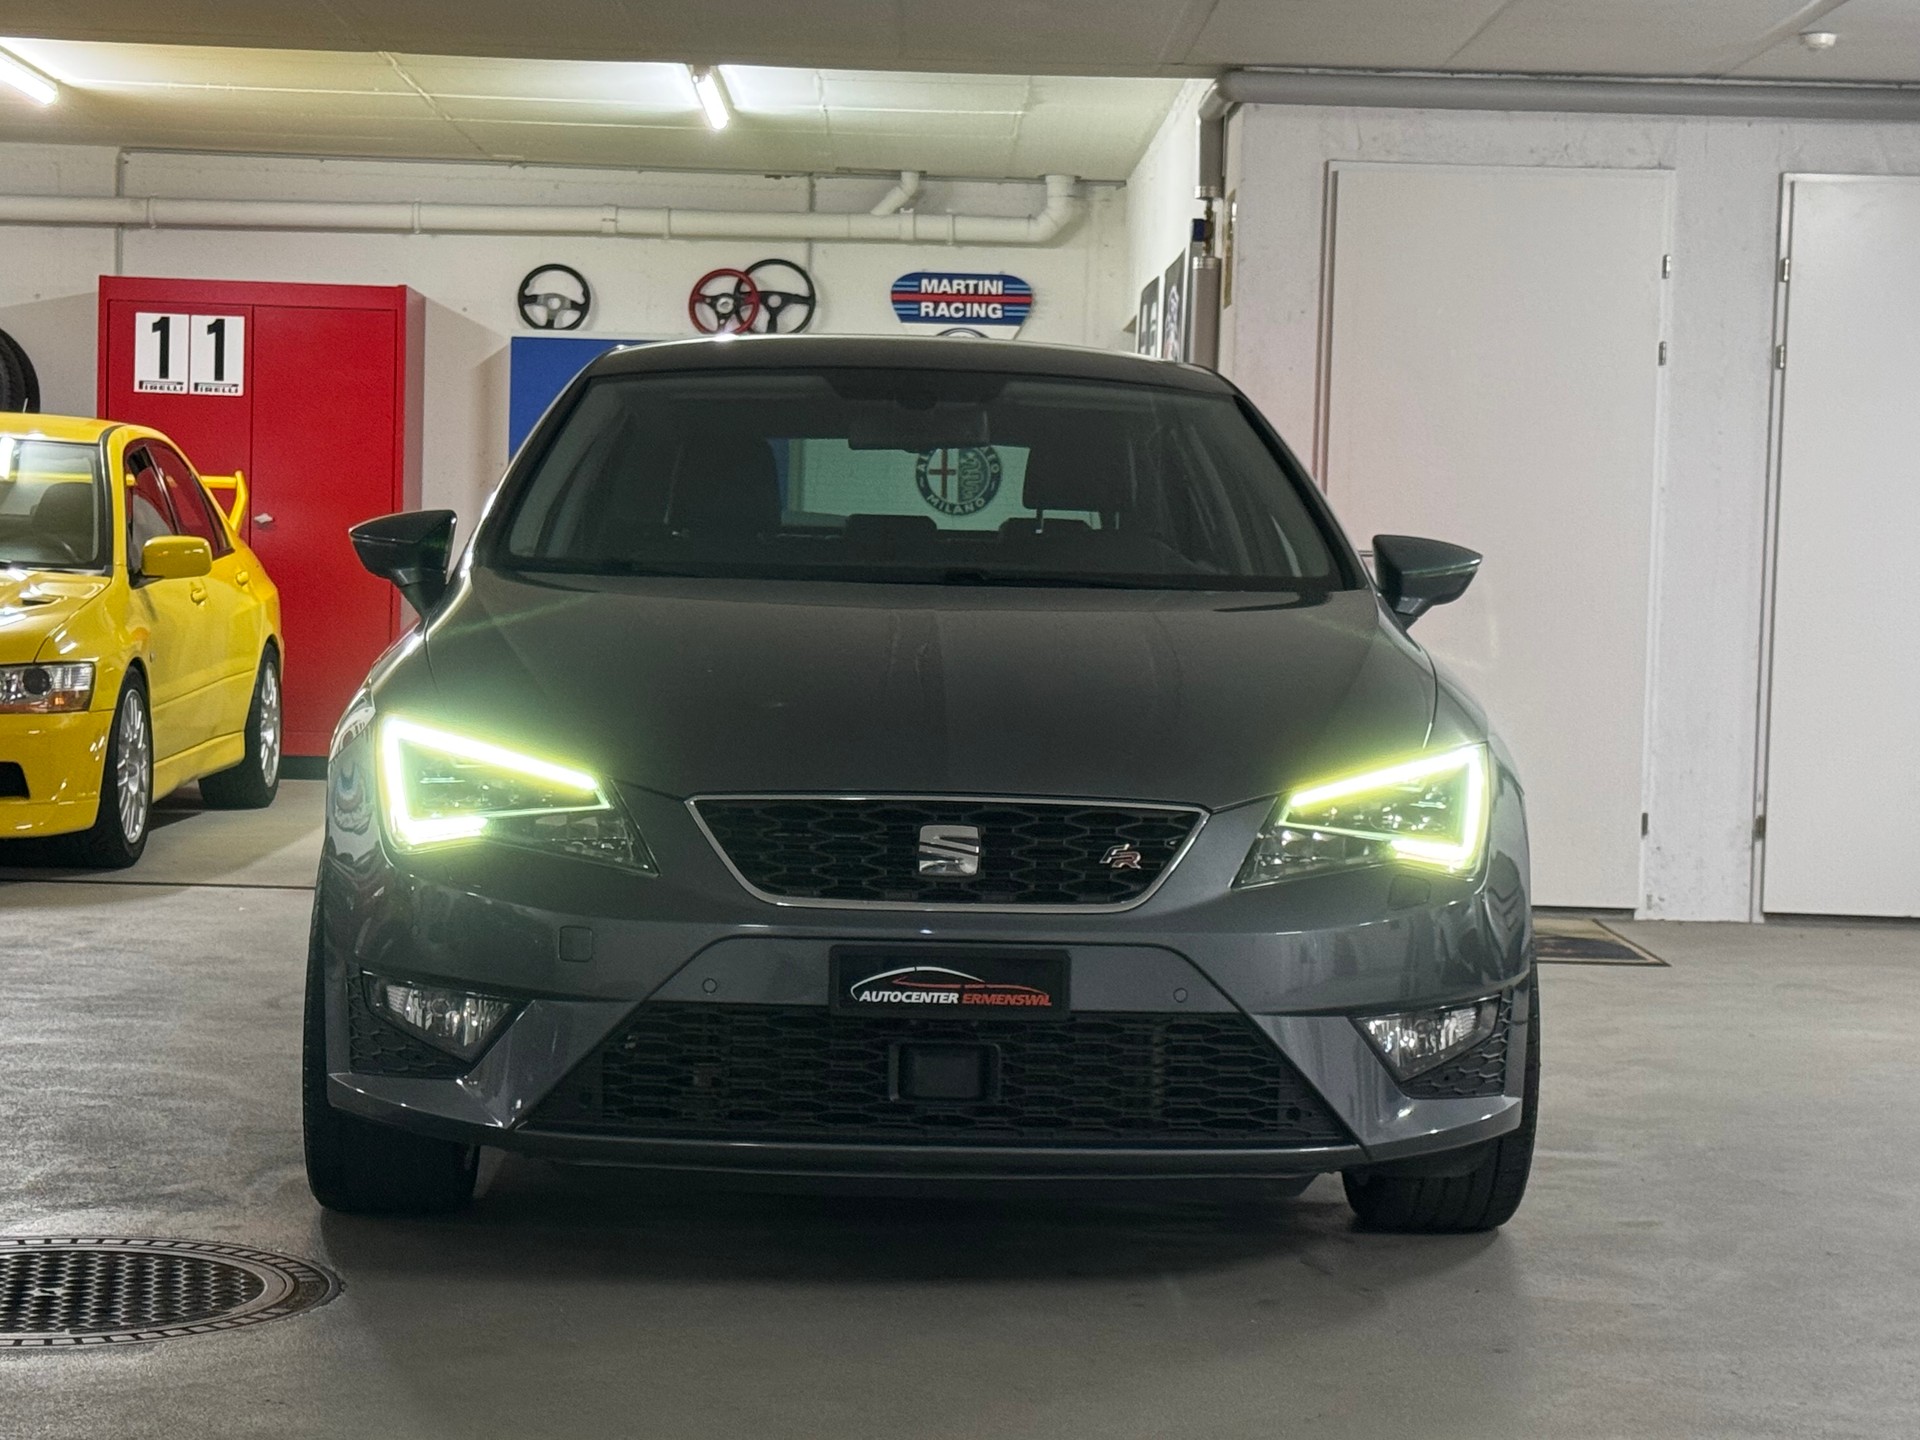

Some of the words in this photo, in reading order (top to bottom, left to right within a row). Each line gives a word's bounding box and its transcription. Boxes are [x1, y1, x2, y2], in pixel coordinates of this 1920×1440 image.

[920, 278, 1003, 295] MARTINI
[920, 302, 1003, 318] RACING
[926, 494, 985, 513] MILANO
[859, 990, 959, 1004] AUTOCENTER
[961, 992, 1052, 1006] ERMENSWIL
